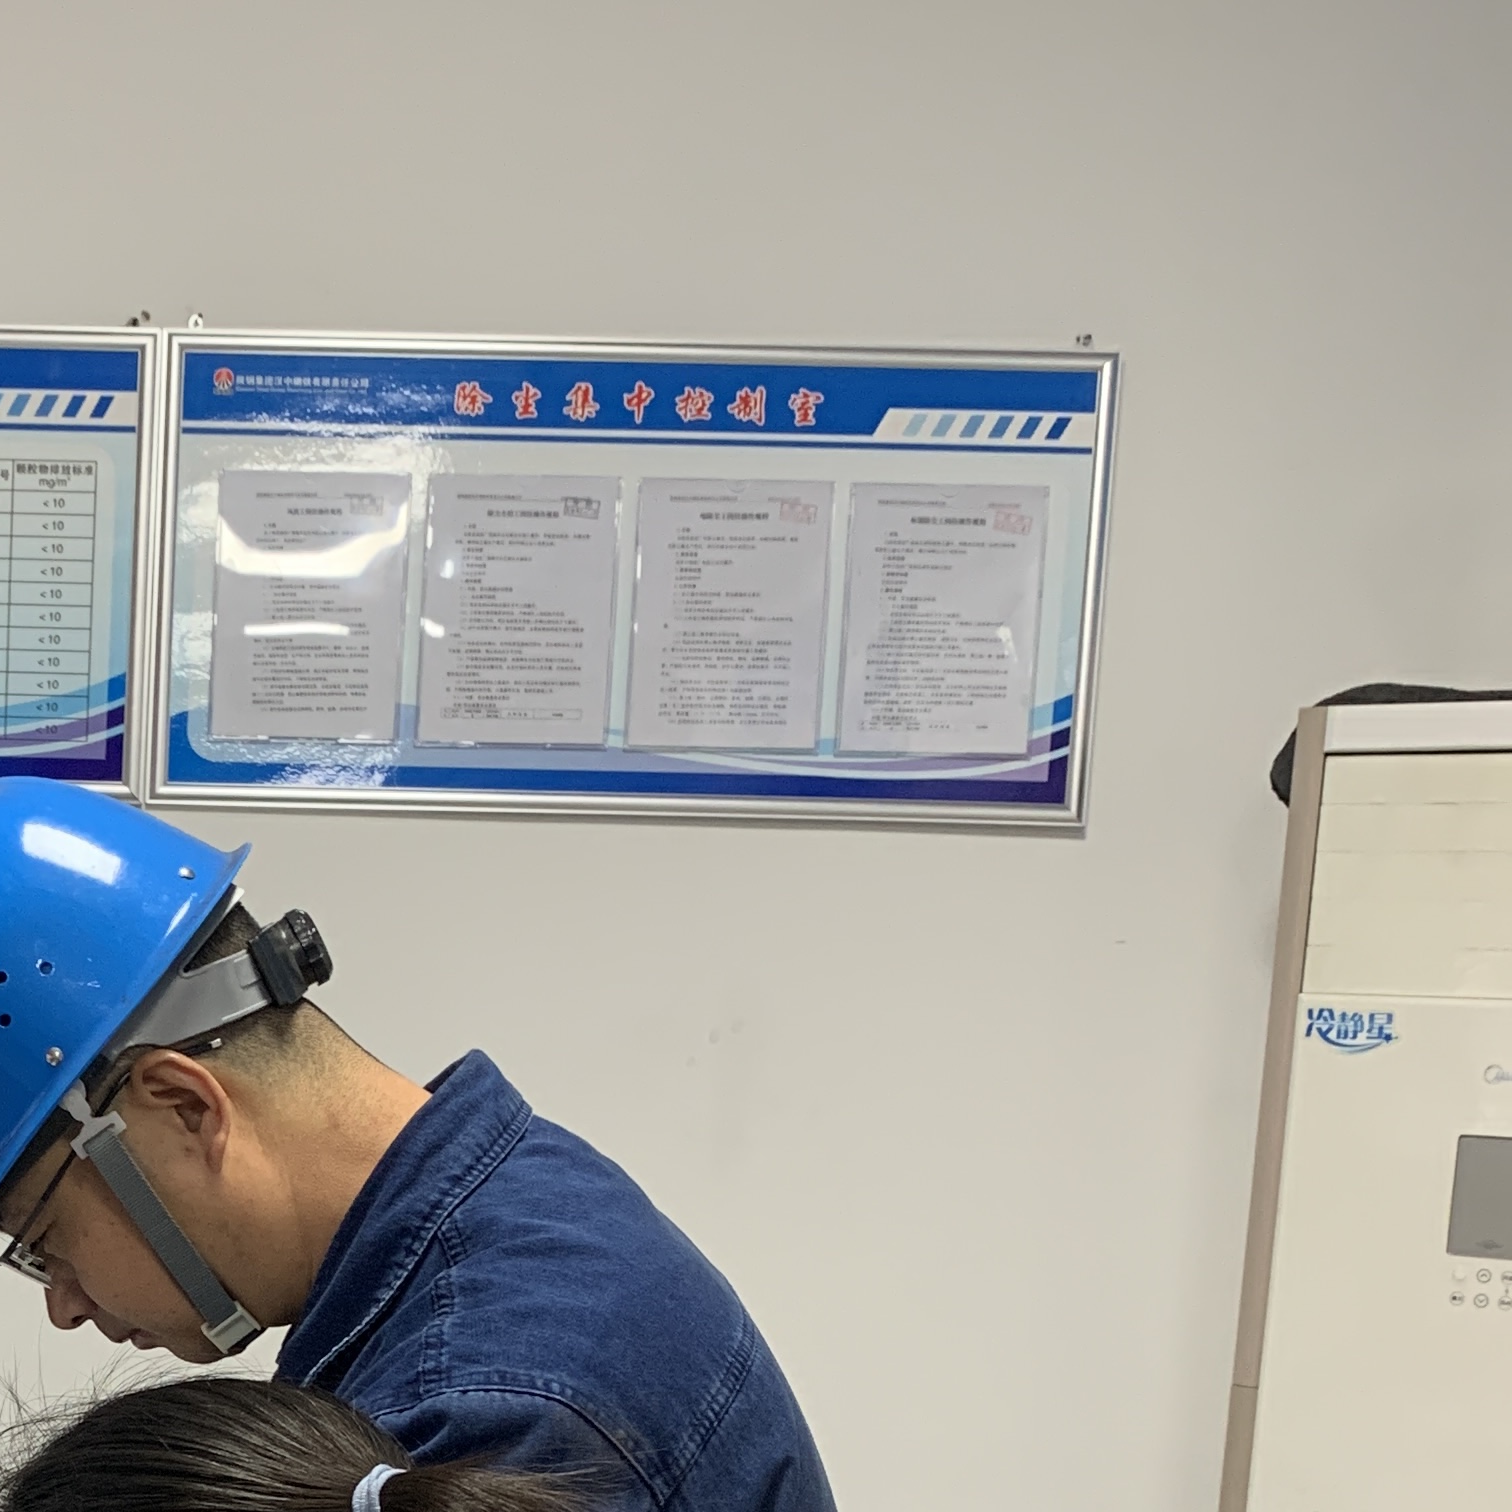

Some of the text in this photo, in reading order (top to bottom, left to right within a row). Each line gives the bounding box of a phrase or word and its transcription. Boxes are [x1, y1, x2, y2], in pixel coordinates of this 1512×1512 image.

[453, 381, 824, 427] 除尘集中控制室
[1305, 1008, 1394, 1041] 冷静星
